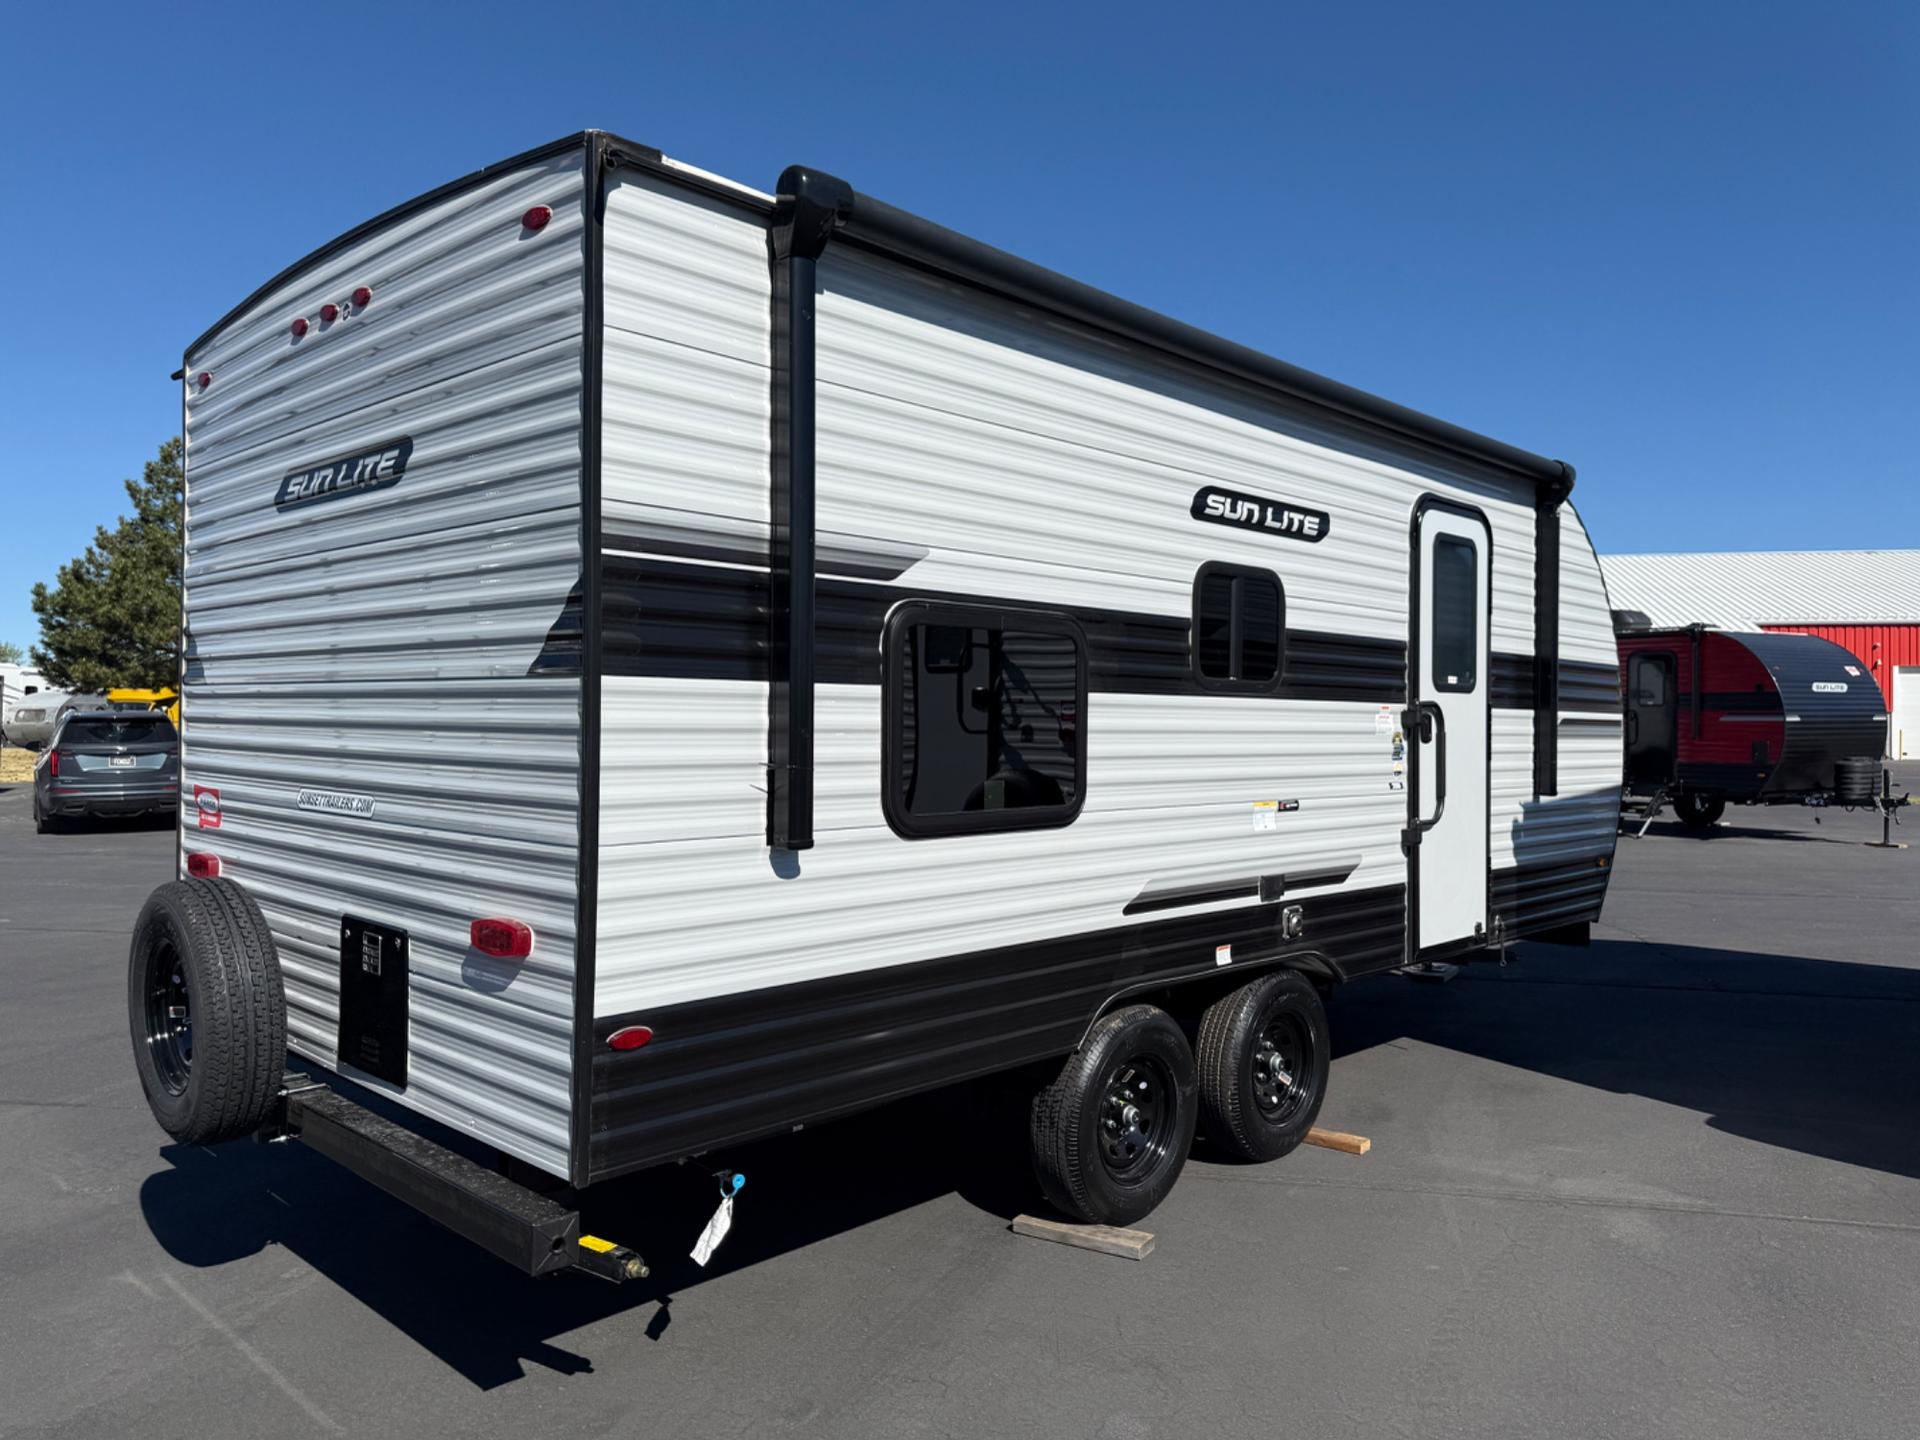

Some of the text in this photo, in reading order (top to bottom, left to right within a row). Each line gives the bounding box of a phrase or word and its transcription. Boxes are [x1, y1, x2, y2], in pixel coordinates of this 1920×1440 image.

[285, 449, 400, 501] SUN LITE
[1204, 494, 1320, 536] SUN LITE
[299, 790, 375, 813] SUNSETTRAILERS.COM
